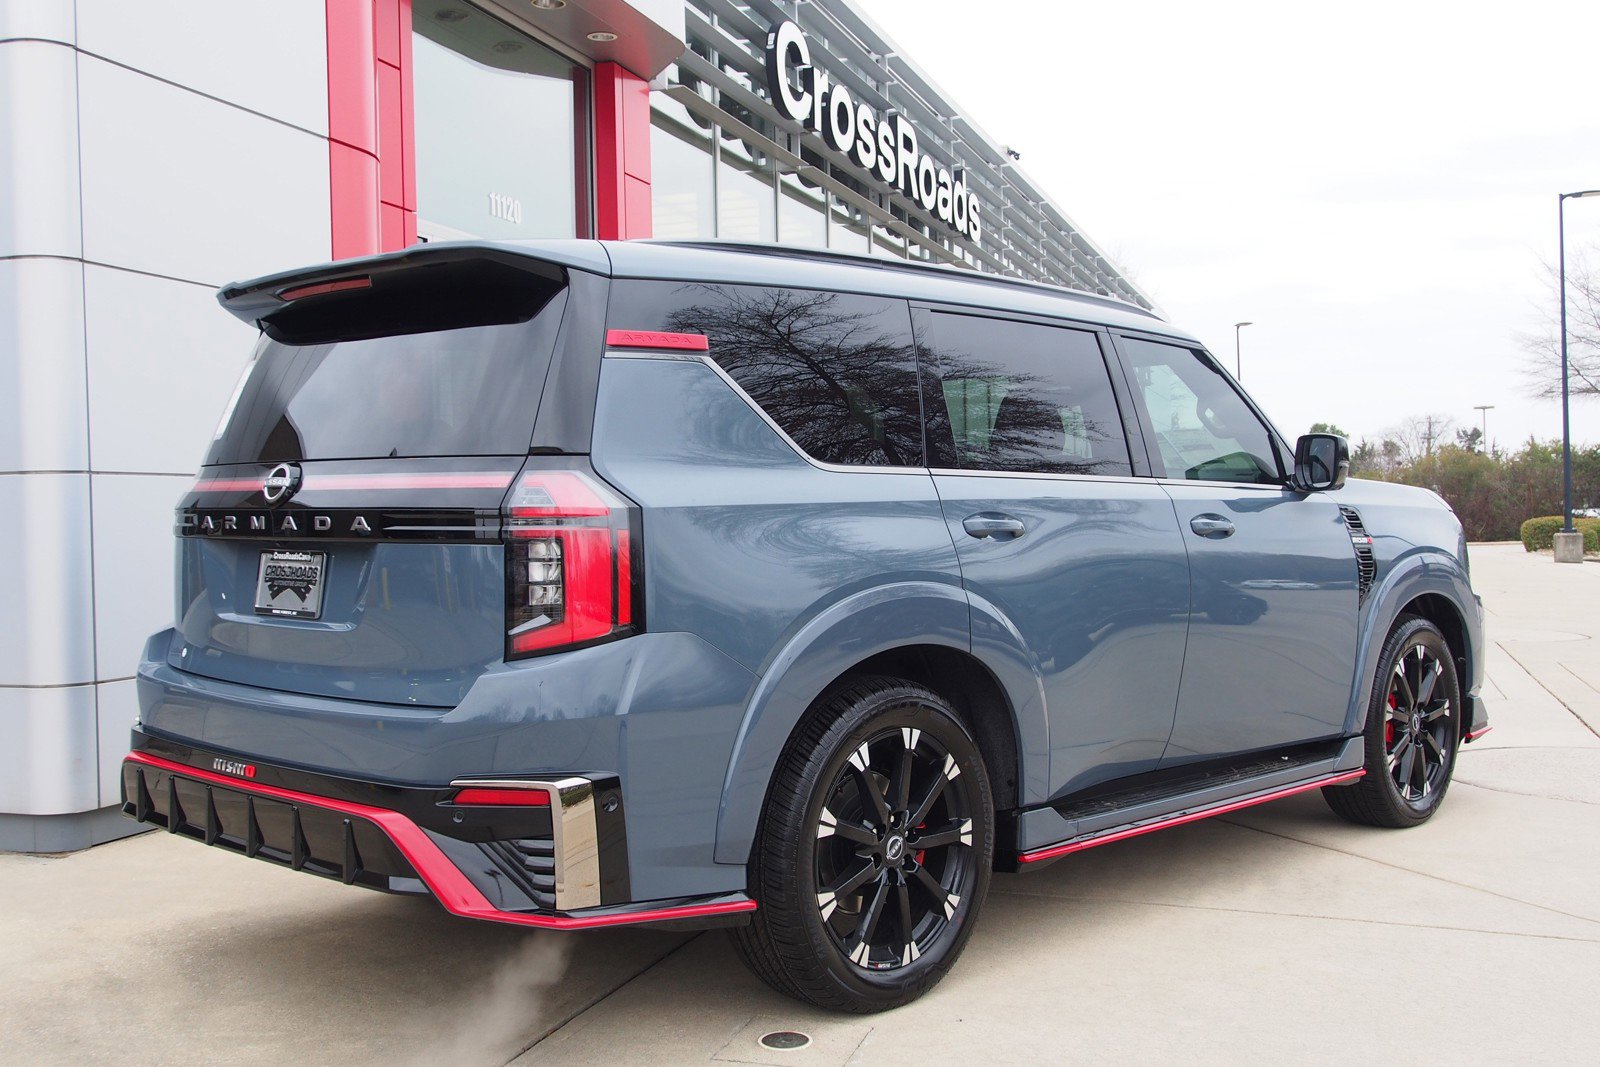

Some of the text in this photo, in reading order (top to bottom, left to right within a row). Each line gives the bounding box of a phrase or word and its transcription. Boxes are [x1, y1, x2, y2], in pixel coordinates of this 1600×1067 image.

[767, 20, 981, 242] CrossRoads
[488, 192, 521, 224] 11120
[201, 516, 372, 531] ARMADA
[265, 565, 318, 578] CROSSROADS
